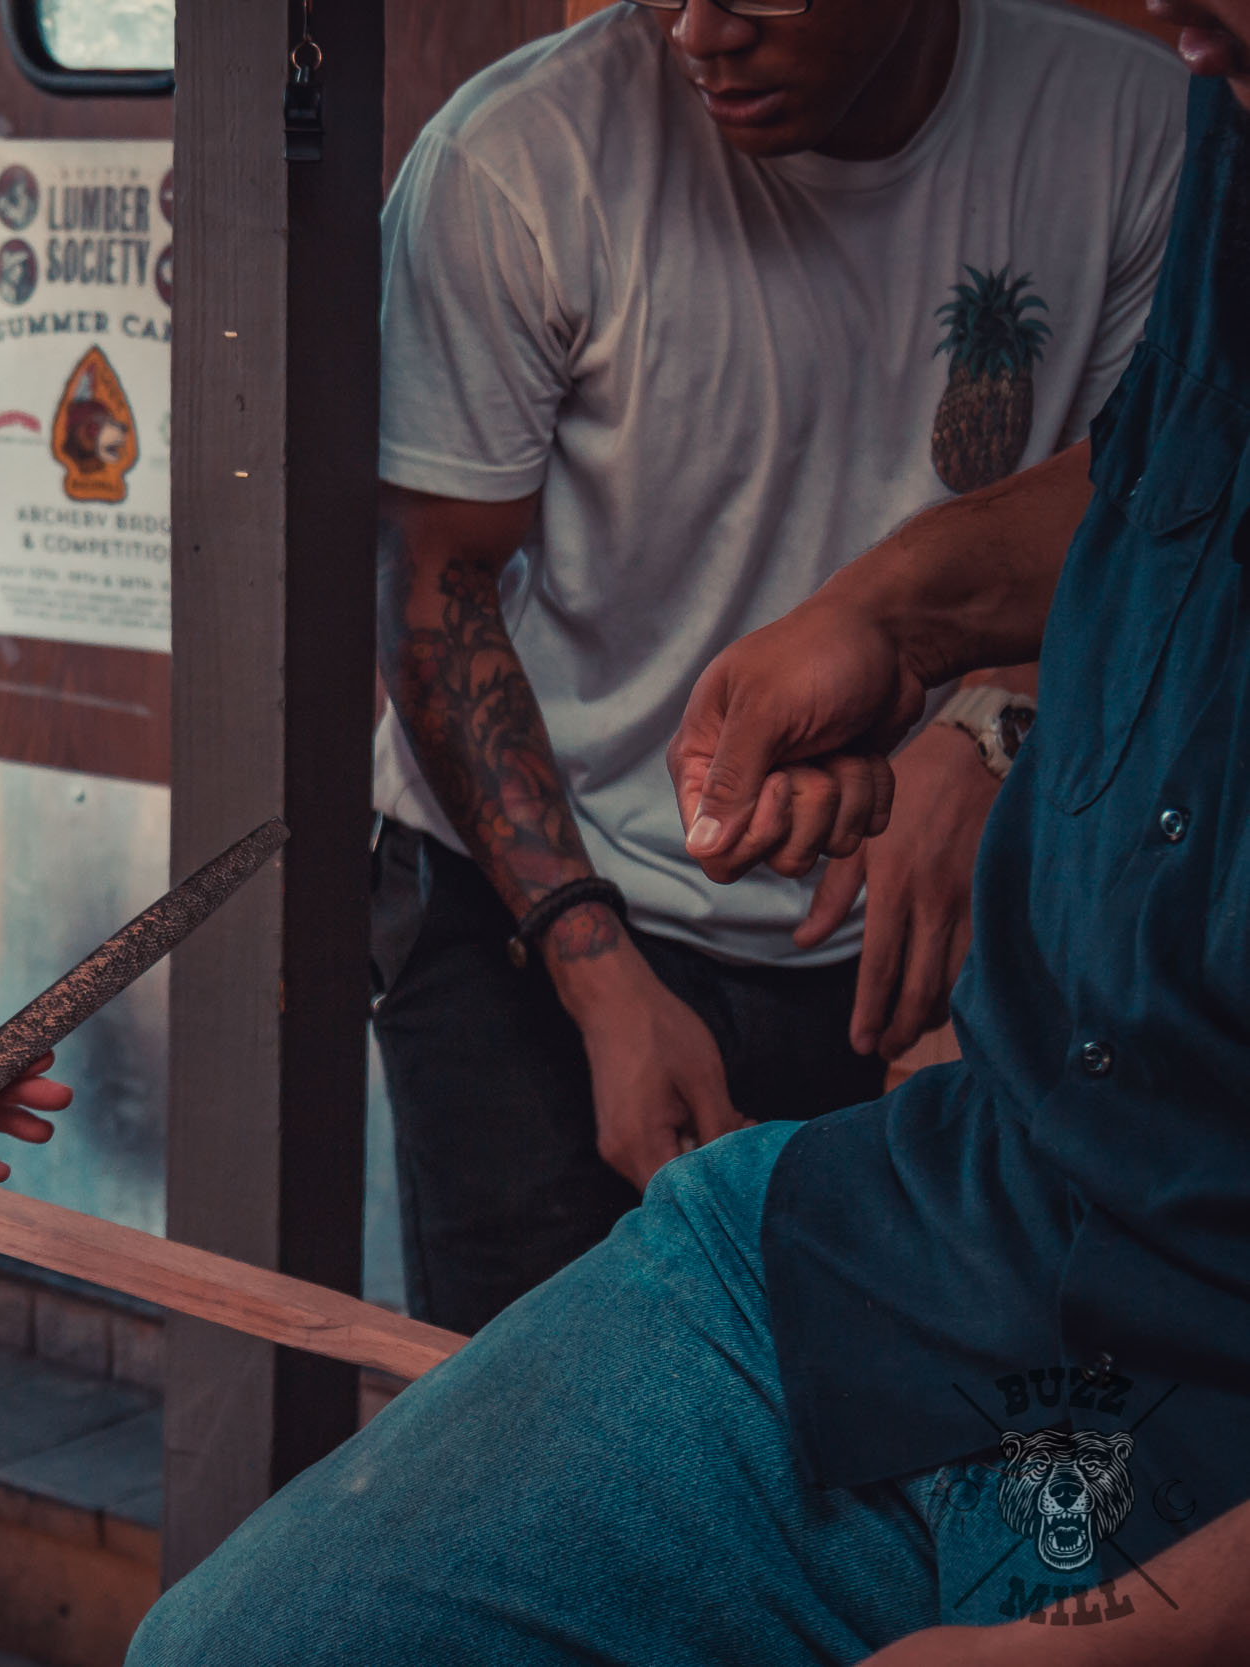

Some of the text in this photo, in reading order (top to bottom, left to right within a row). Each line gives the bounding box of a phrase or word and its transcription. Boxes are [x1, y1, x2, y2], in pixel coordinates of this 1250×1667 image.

[47, 185, 151, 232] LUMBER
[46, 237, 150, 286] SOCIETY
[16, 506, 108, 528] ARCHERY
